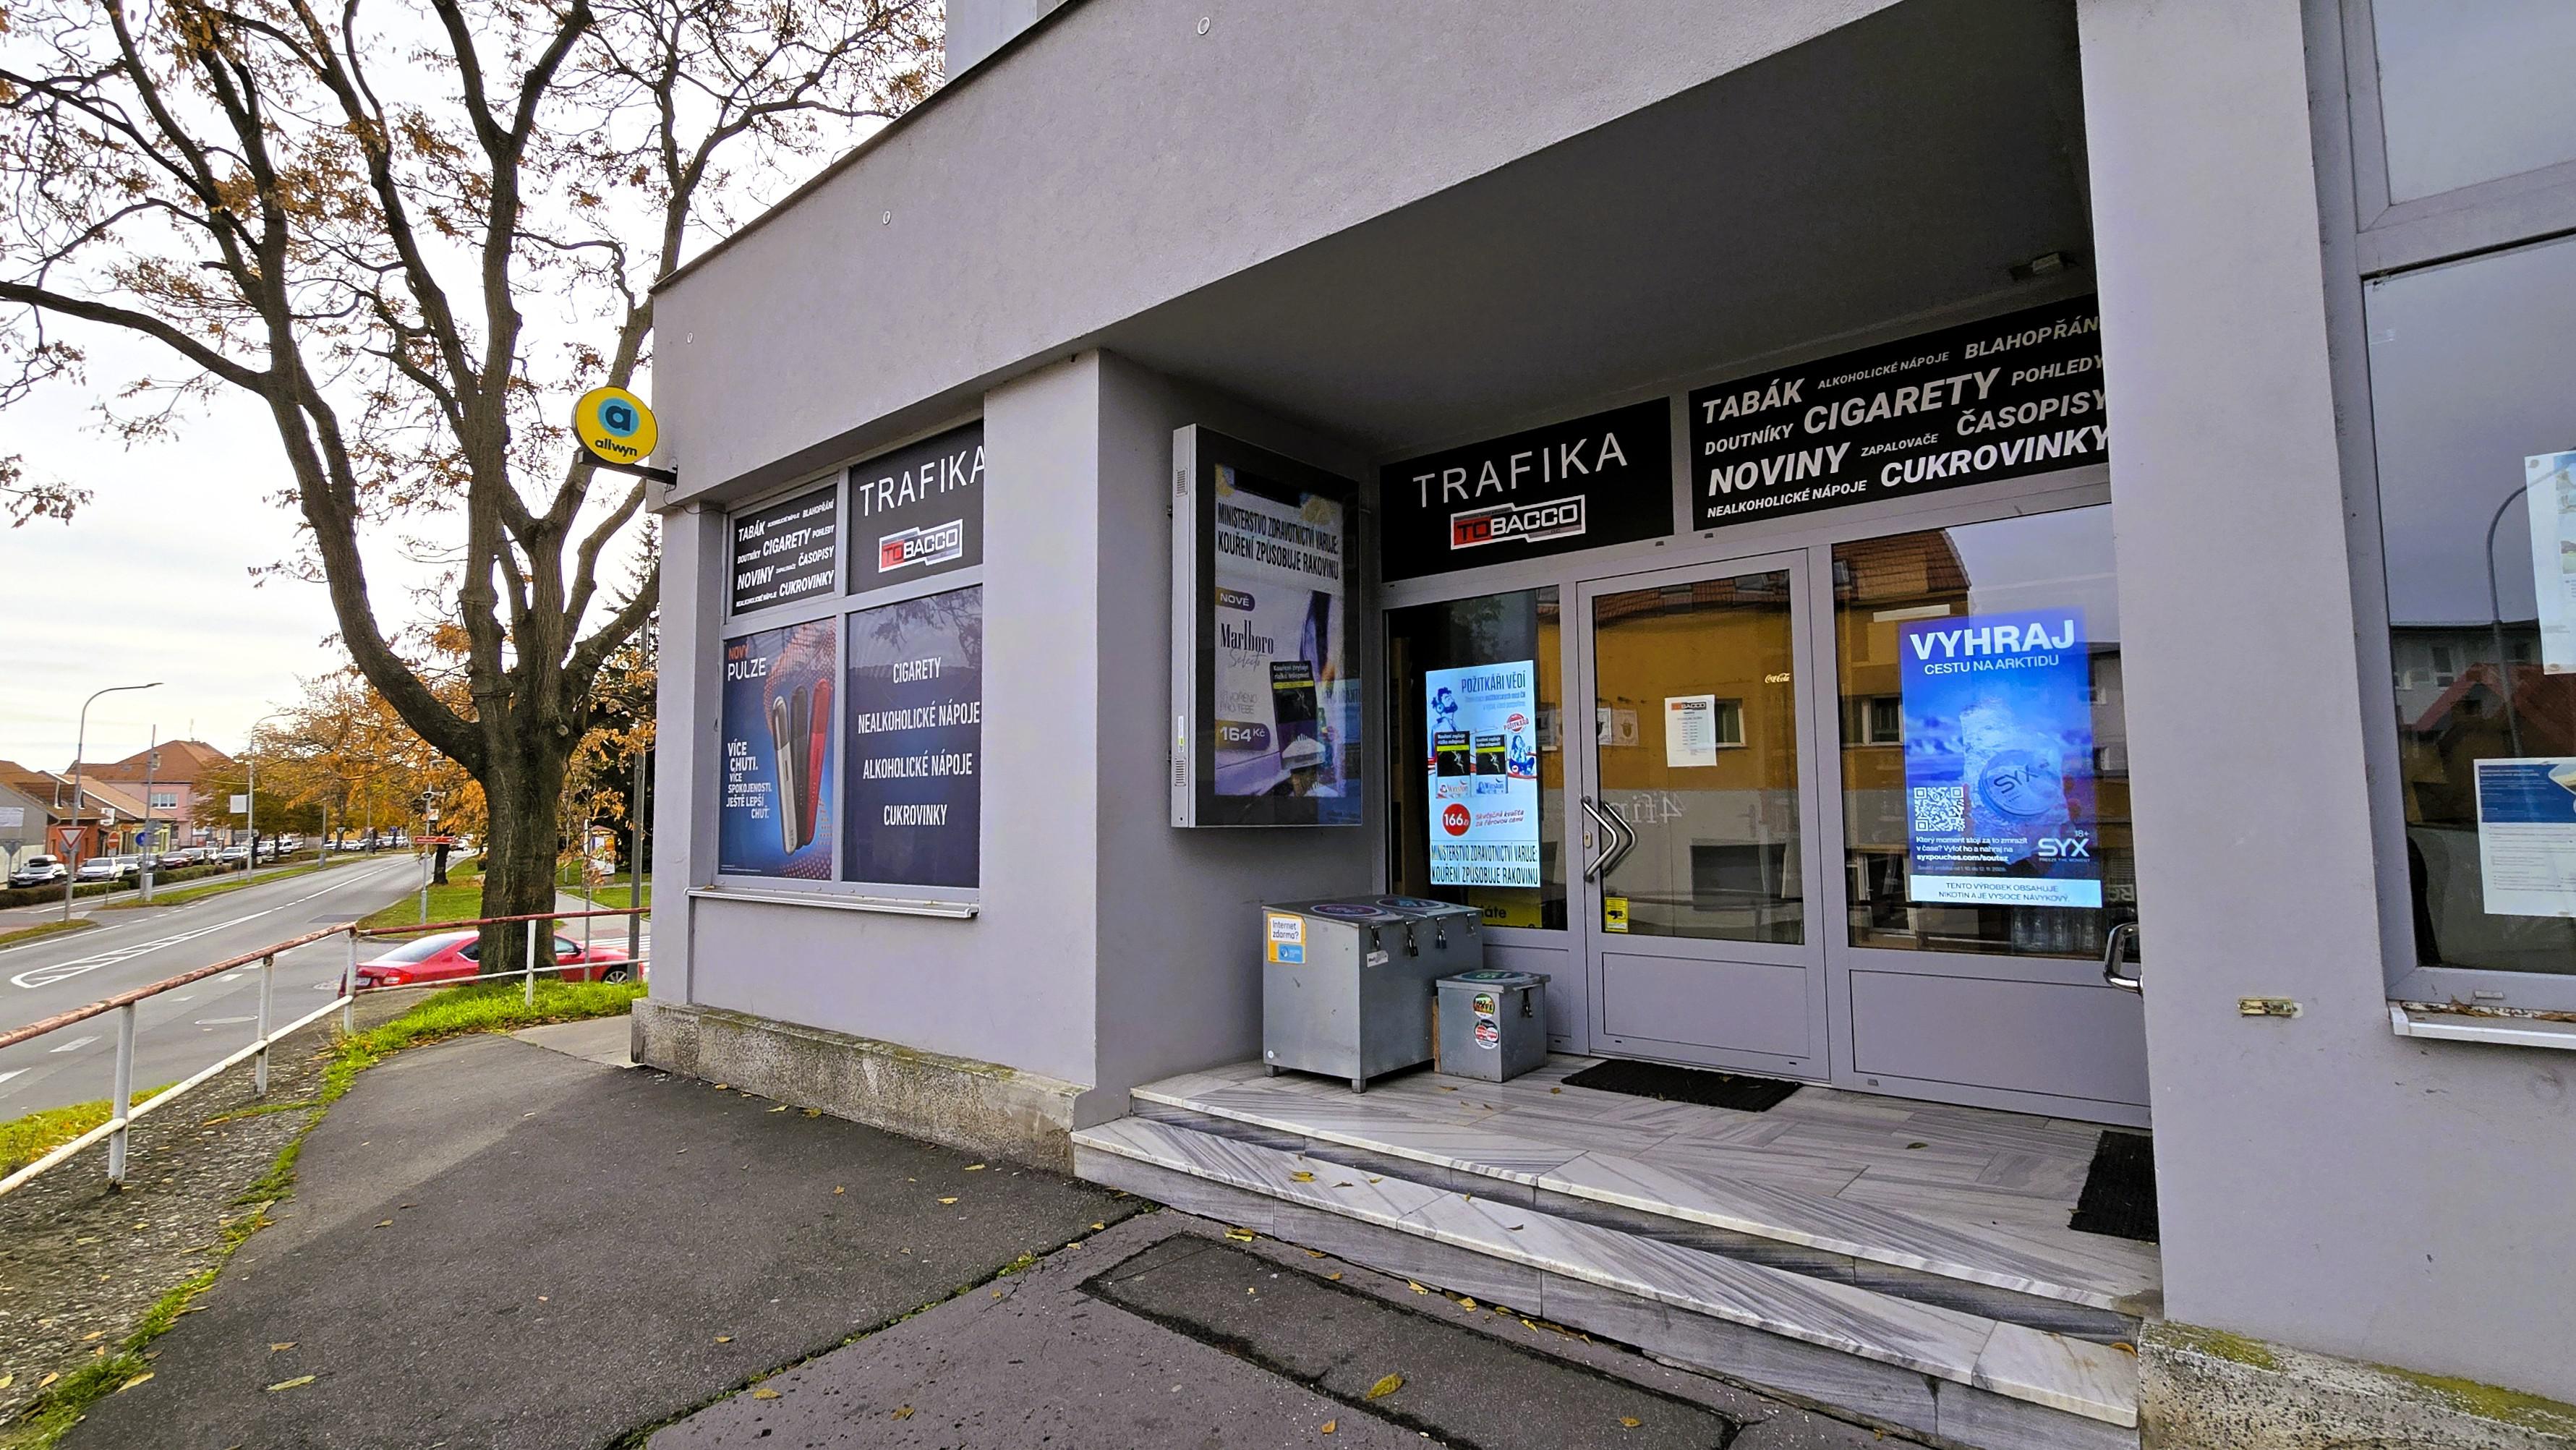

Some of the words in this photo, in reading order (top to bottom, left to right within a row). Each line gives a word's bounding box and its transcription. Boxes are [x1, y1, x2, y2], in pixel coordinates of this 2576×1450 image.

[1702, 378, 1806, 425] TABÁK
[1817, 362, 1898, 390] ALKOHOLICKÉ
[1900, 351, 1950, 371] NÁPOJE
[1965, 315, 2100, 359] BLAHOPŘÁN
[1705, 423, 1794, 456] DOUTNÍKY
[1804, 367, 2001, 434] CIGARETY
[2011, 355, 2103, 386] POHLEDY
[594, 438, 638, 457] allwyn
[1708, 441, 1851, 497] NOVINY
[1861, 432, 1939, 457] ZAPALOVAČE
[1956, 388, 2106, 436] ČASOPISY
[859, 445, 985, 516] TRAFIKA
[1412, 432, 1628, 508] TRAFIKA
[1707, 487, 1811, 519] NEALKOHOLICKÉ
[1812, 479, 1867, 500] NÁPOJE
[1880, 425, 2109, 488] CUKROVINKY
[738, 520, 766, 542] TABÁK
[1218, 502, 1266, 536] MINISTERSTVO
[1268, 517, 1315, 549] ZDRAVOTNICTVÍ
[1457, 504, 1578, 541] TOBACCO
[763, 527, 811, 557] CIGARETY
[812, 524, 835, 539] POHLEDY
[883, 528, 958, 564] TOBACCO
[736, 565, 775, 590] NOVINY
[798, 545, 835, 567] ČASOPISY
[1218, 530, 1255, 560] KOUŘENÍ
[1256, 539, 1301, 571] ZPŮSOBUJE
[1303, 553, 1339, 580] RAKOVINU
[779, 569, 835, 597] CUKROVINKY
[1220, 593, 1250, 607] NOVÉ
[1221, 619, 1274, 654] Marlboro
[1909, 619, 2075, 660] VYHRAJ
[728, 657, 767, 681] PULZE
[893, 657, 942, 684] CIGARETY
[1924, 661, 1971, 675] CESTU
[1973, 660, 1994, 672] NA
[1995, 654, 2059, 670] ARKTIDU
[1462, 673, 1504, 694] POŽITKÁŘI
[1506, 670, 1526, 689] VĚDÍ
[858, 700, 936, 734] NEALKOHOLICKÉ
[939, 699, 981, 727] NÁPOJE
[1220, 726, 1251, 742] 164
[1253, 728, 1266, 737] Kč
[728, 738, 747, 756] VÍCE
[730, 756, 759, 772] CHUTI.
[863, 750, 929, 780] ALKOHOLICKÉ
[931, 749, 973, 777] NÁPOJE
[1994, 764, 2039, 794] SYX
[726, 794, 745, 807] JEŠTĚ
[746, 793, 764, 807] LEPŠÍ
[884, 804, 948, 827] CUKROVINKY
[1444, 814, 1464, 827] 166
[1431, 845, 1470, 861] MINISTERSTVO
[1470, 843, 1514, 862] ZDRAVOTNICTVÍ
[1979, 845, 2003, 854] nahraj
[2038, 837, 2090, 858] SYX
[1432, 863, 1460, 882] KOUŘENÍ
[1462, 863, 1501, 884] ZPŮSOBUJE
[1502, 867, 1538, 884] RAKOVINU
[1973, 882, 2012, 891] VÝROBEK
[1272, 929, 1300, 939] zdarma?
[1273, 920, 1297, 931] Internet
